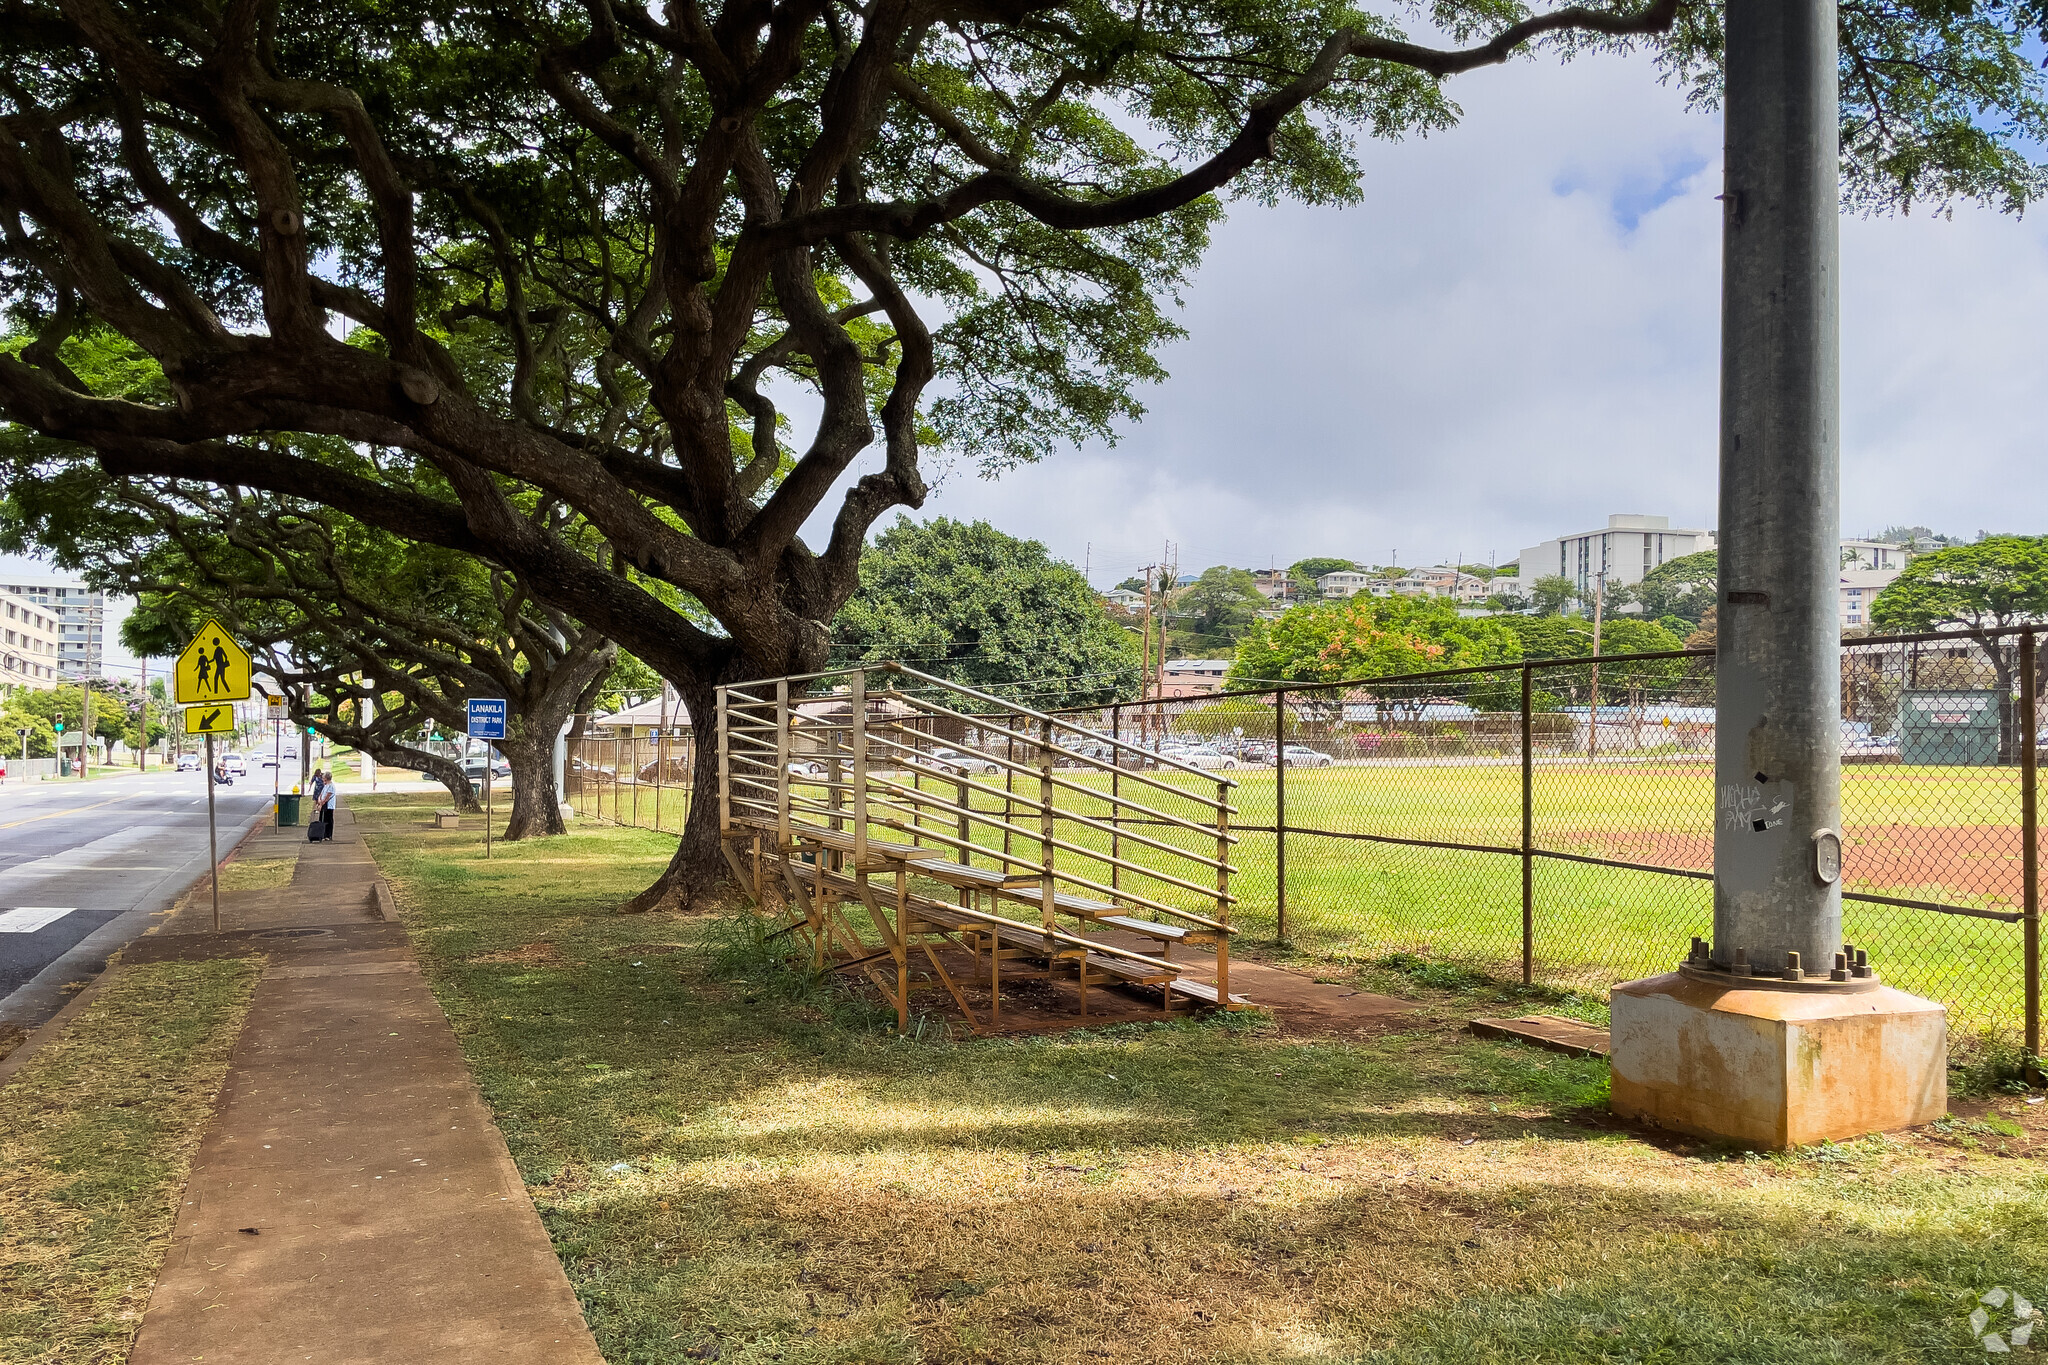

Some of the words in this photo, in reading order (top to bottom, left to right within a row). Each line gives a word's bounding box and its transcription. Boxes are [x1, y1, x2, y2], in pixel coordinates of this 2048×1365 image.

[471, 704, 503, 713] LANAKILA
[471, 716, 491, 724] DISTRICT
[491, 716, 503, 724] PARK
